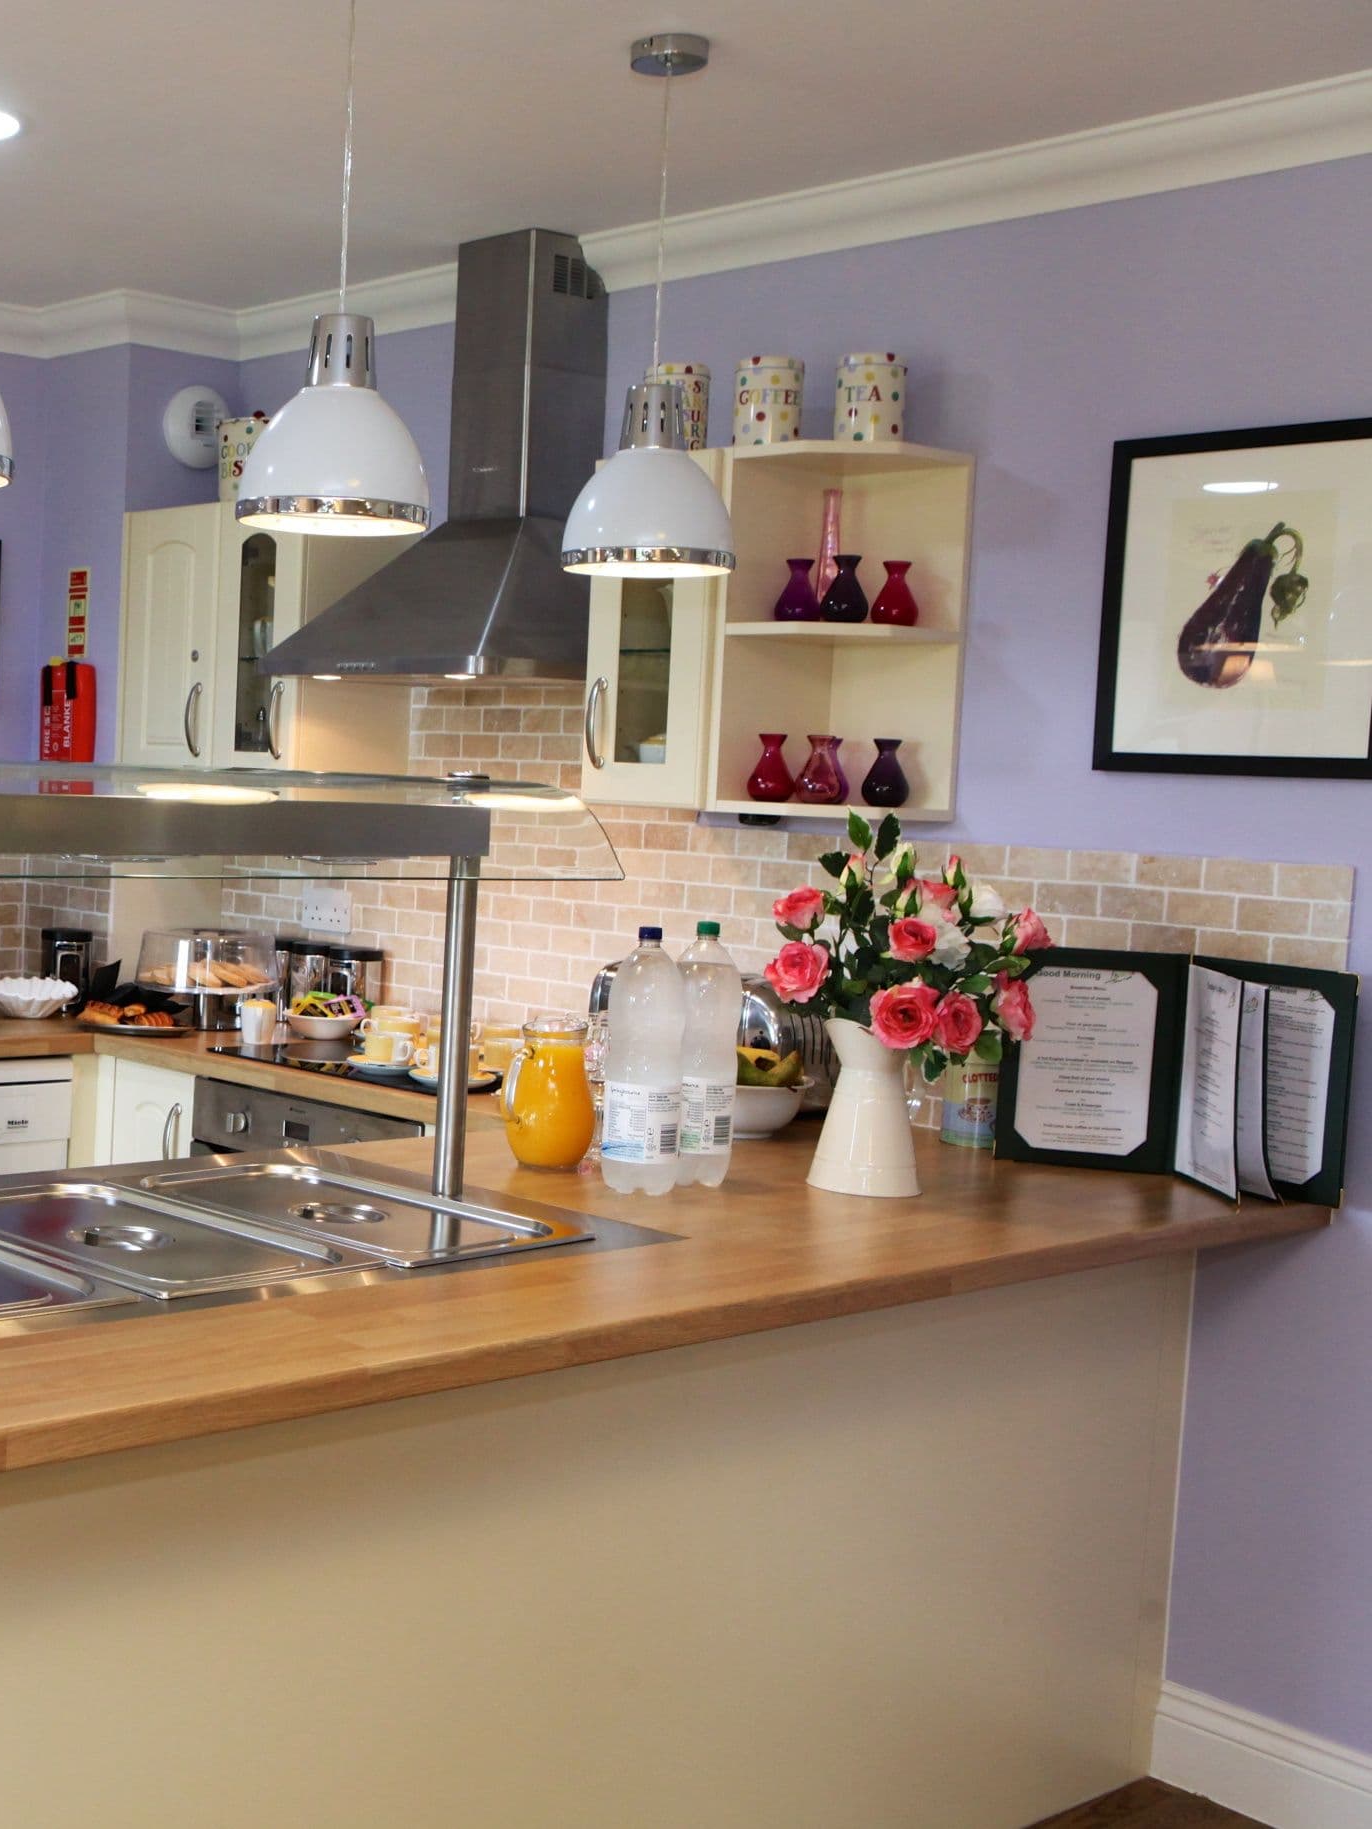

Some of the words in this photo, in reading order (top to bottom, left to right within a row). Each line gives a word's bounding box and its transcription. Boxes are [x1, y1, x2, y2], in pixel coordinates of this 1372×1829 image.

[739, 389, 799, 405] COFFEE
[845, 385, 882, 402] TEA
[63, 692, 71, 748] BLANKE
[1063, 970, 1101, 981] Morning
